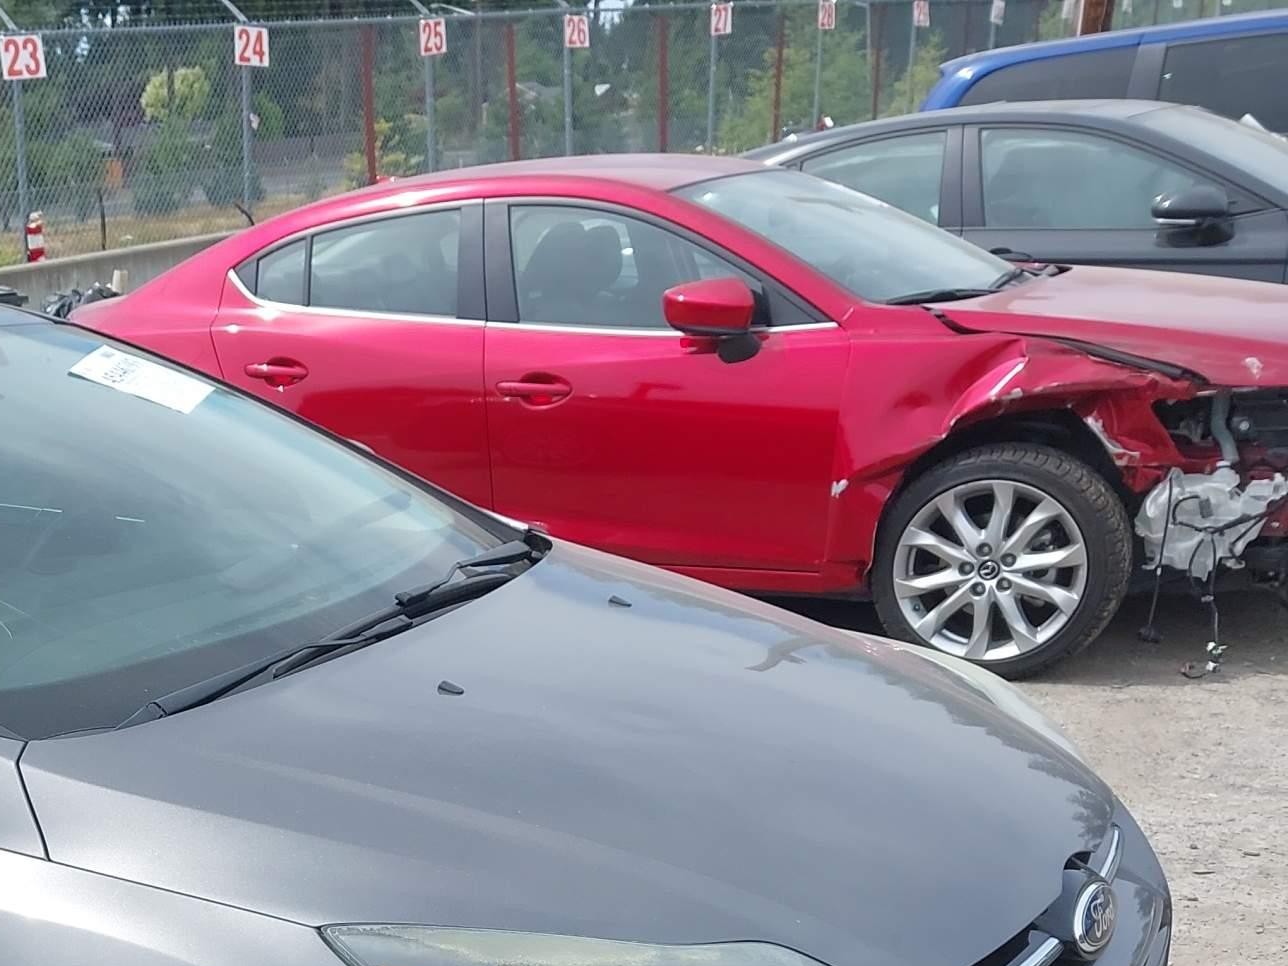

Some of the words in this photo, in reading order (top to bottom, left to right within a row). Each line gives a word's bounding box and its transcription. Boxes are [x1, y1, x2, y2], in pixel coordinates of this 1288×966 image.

[238, 30, 266, 64] 24
[423, 21, 443, 54] 25
[567, 17, 586, 46] 26
[3, 38, 41, 78] 23
